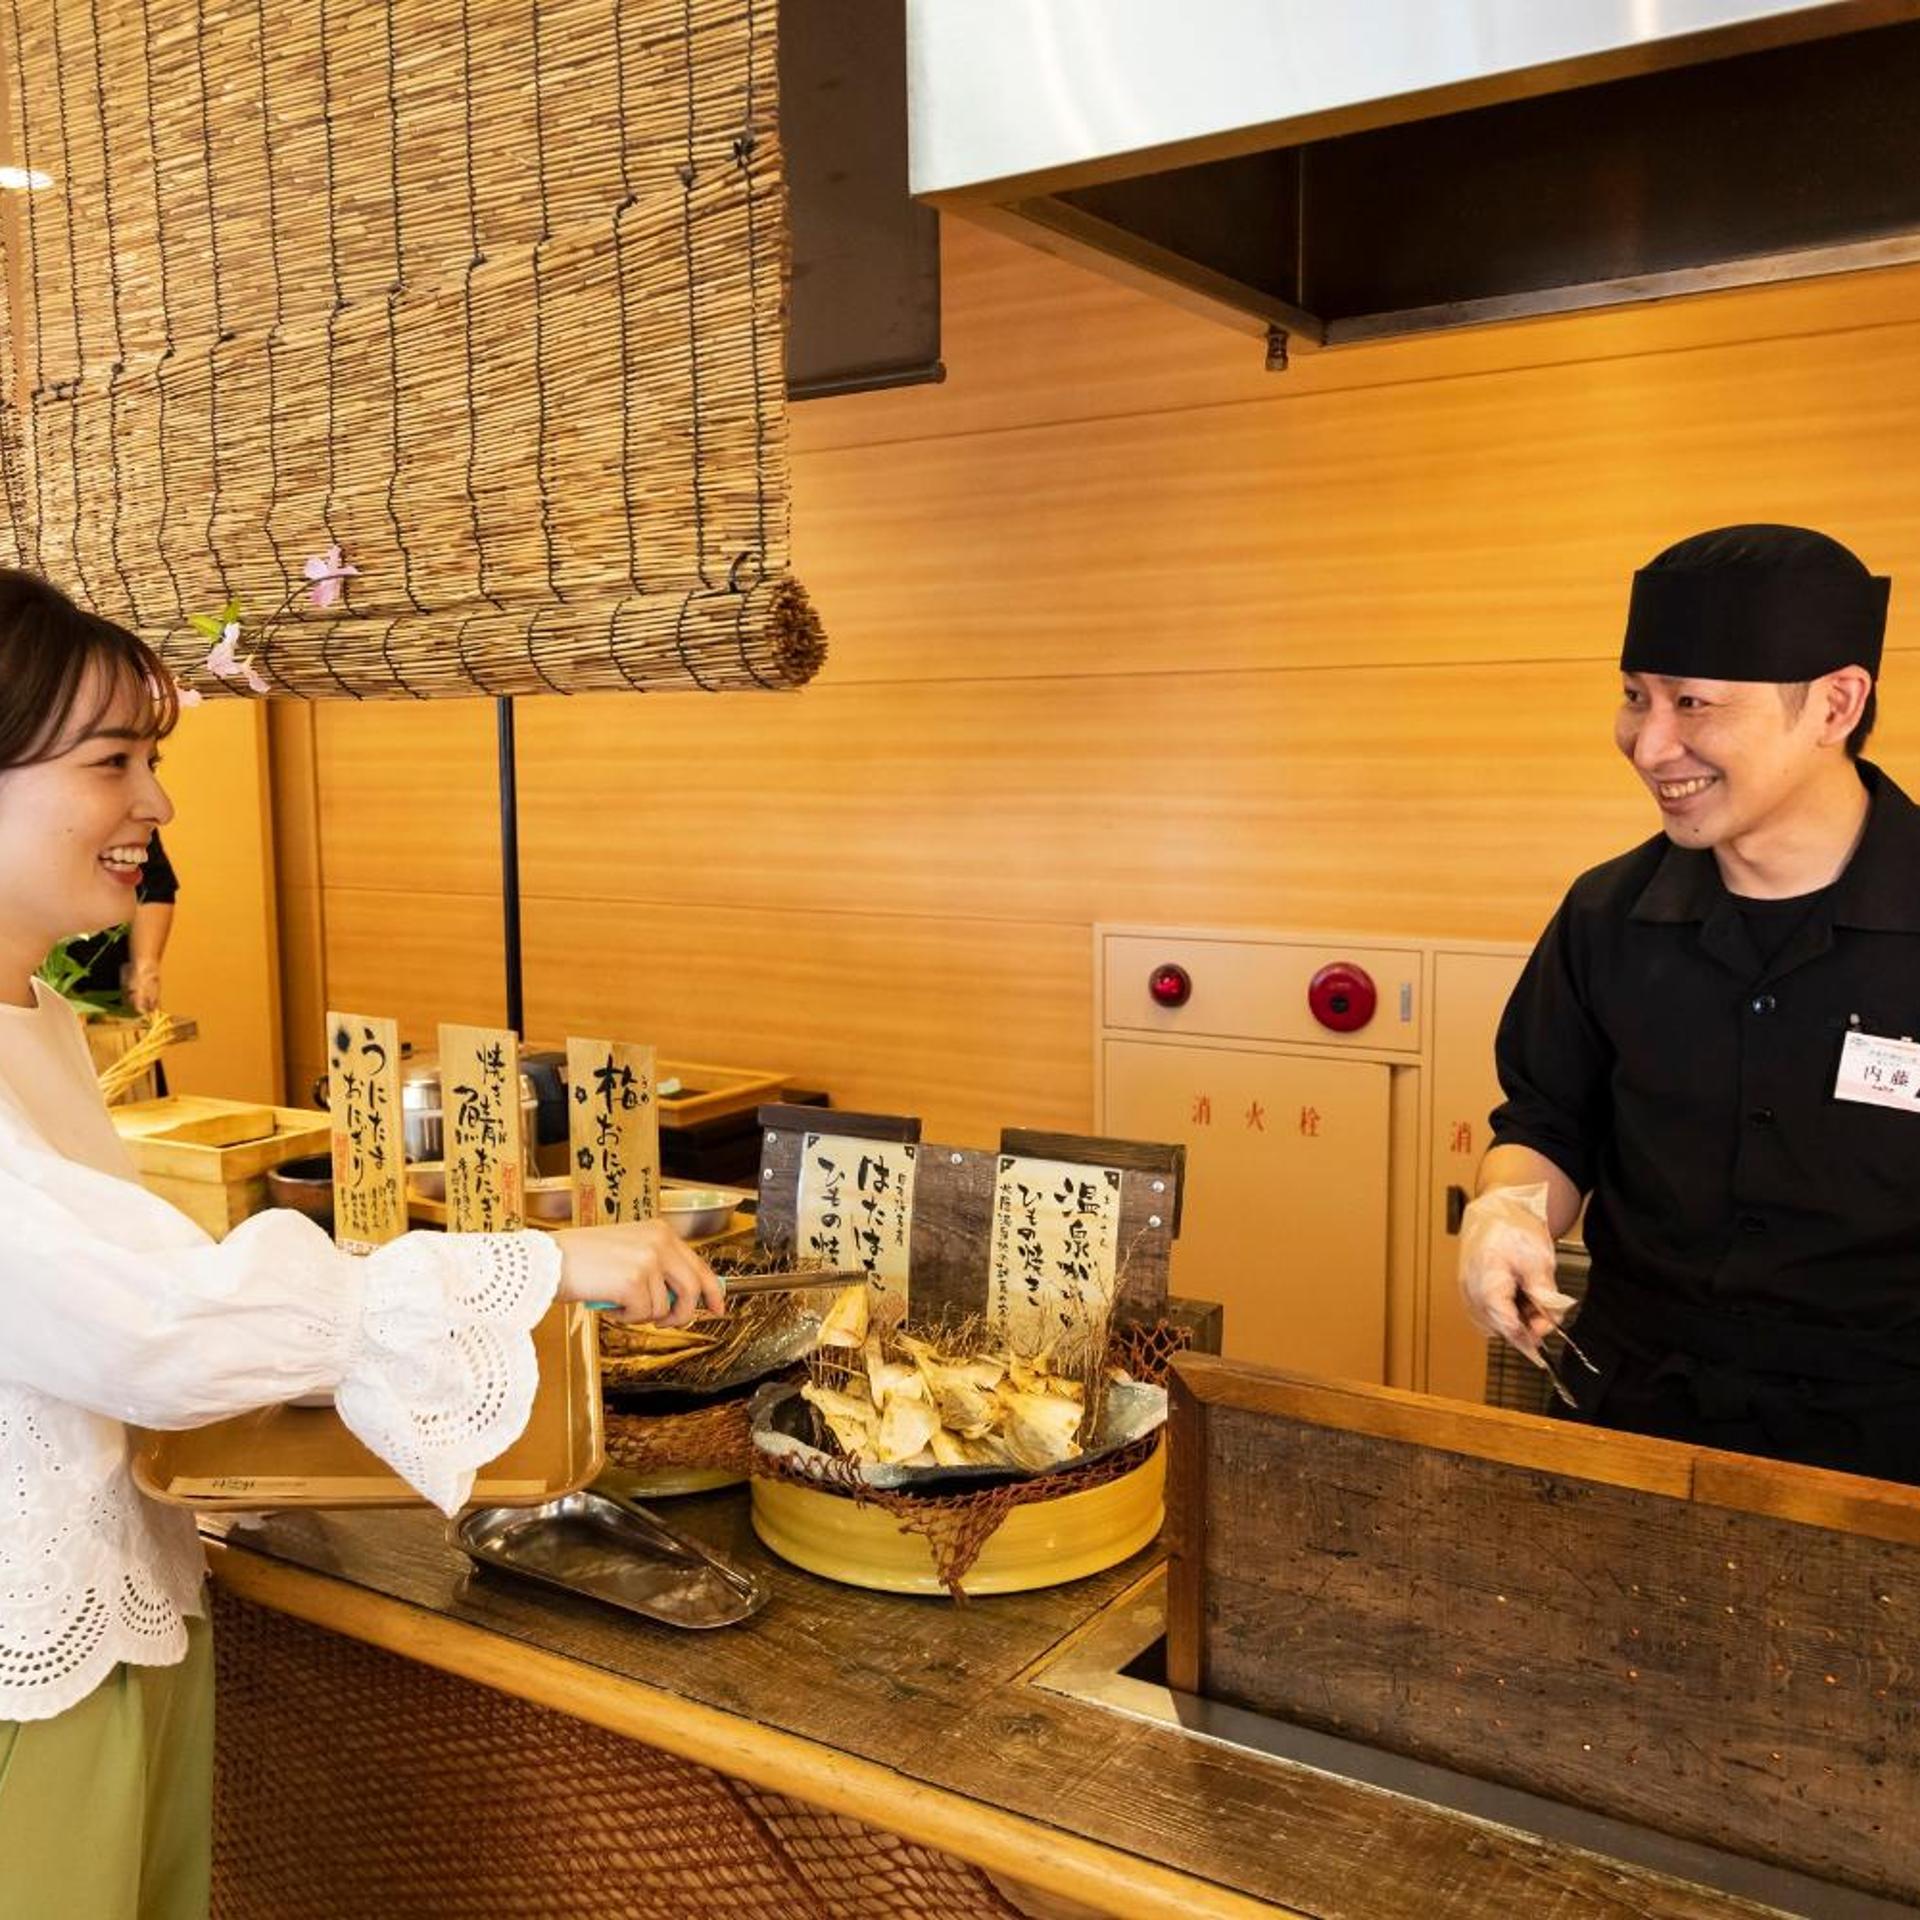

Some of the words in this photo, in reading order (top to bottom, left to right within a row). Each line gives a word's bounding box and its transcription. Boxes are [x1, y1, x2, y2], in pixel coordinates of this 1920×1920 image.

[343, 1073, 368, 1188] おにぎり
[361, 1026, 388, 1171] うにたま
[1192, 1096, 1322, 1138] 消火栓
[853, 1155, 891, 1292] はたはた
[1017, 1183, 1046, 1307] ひもの焼き
